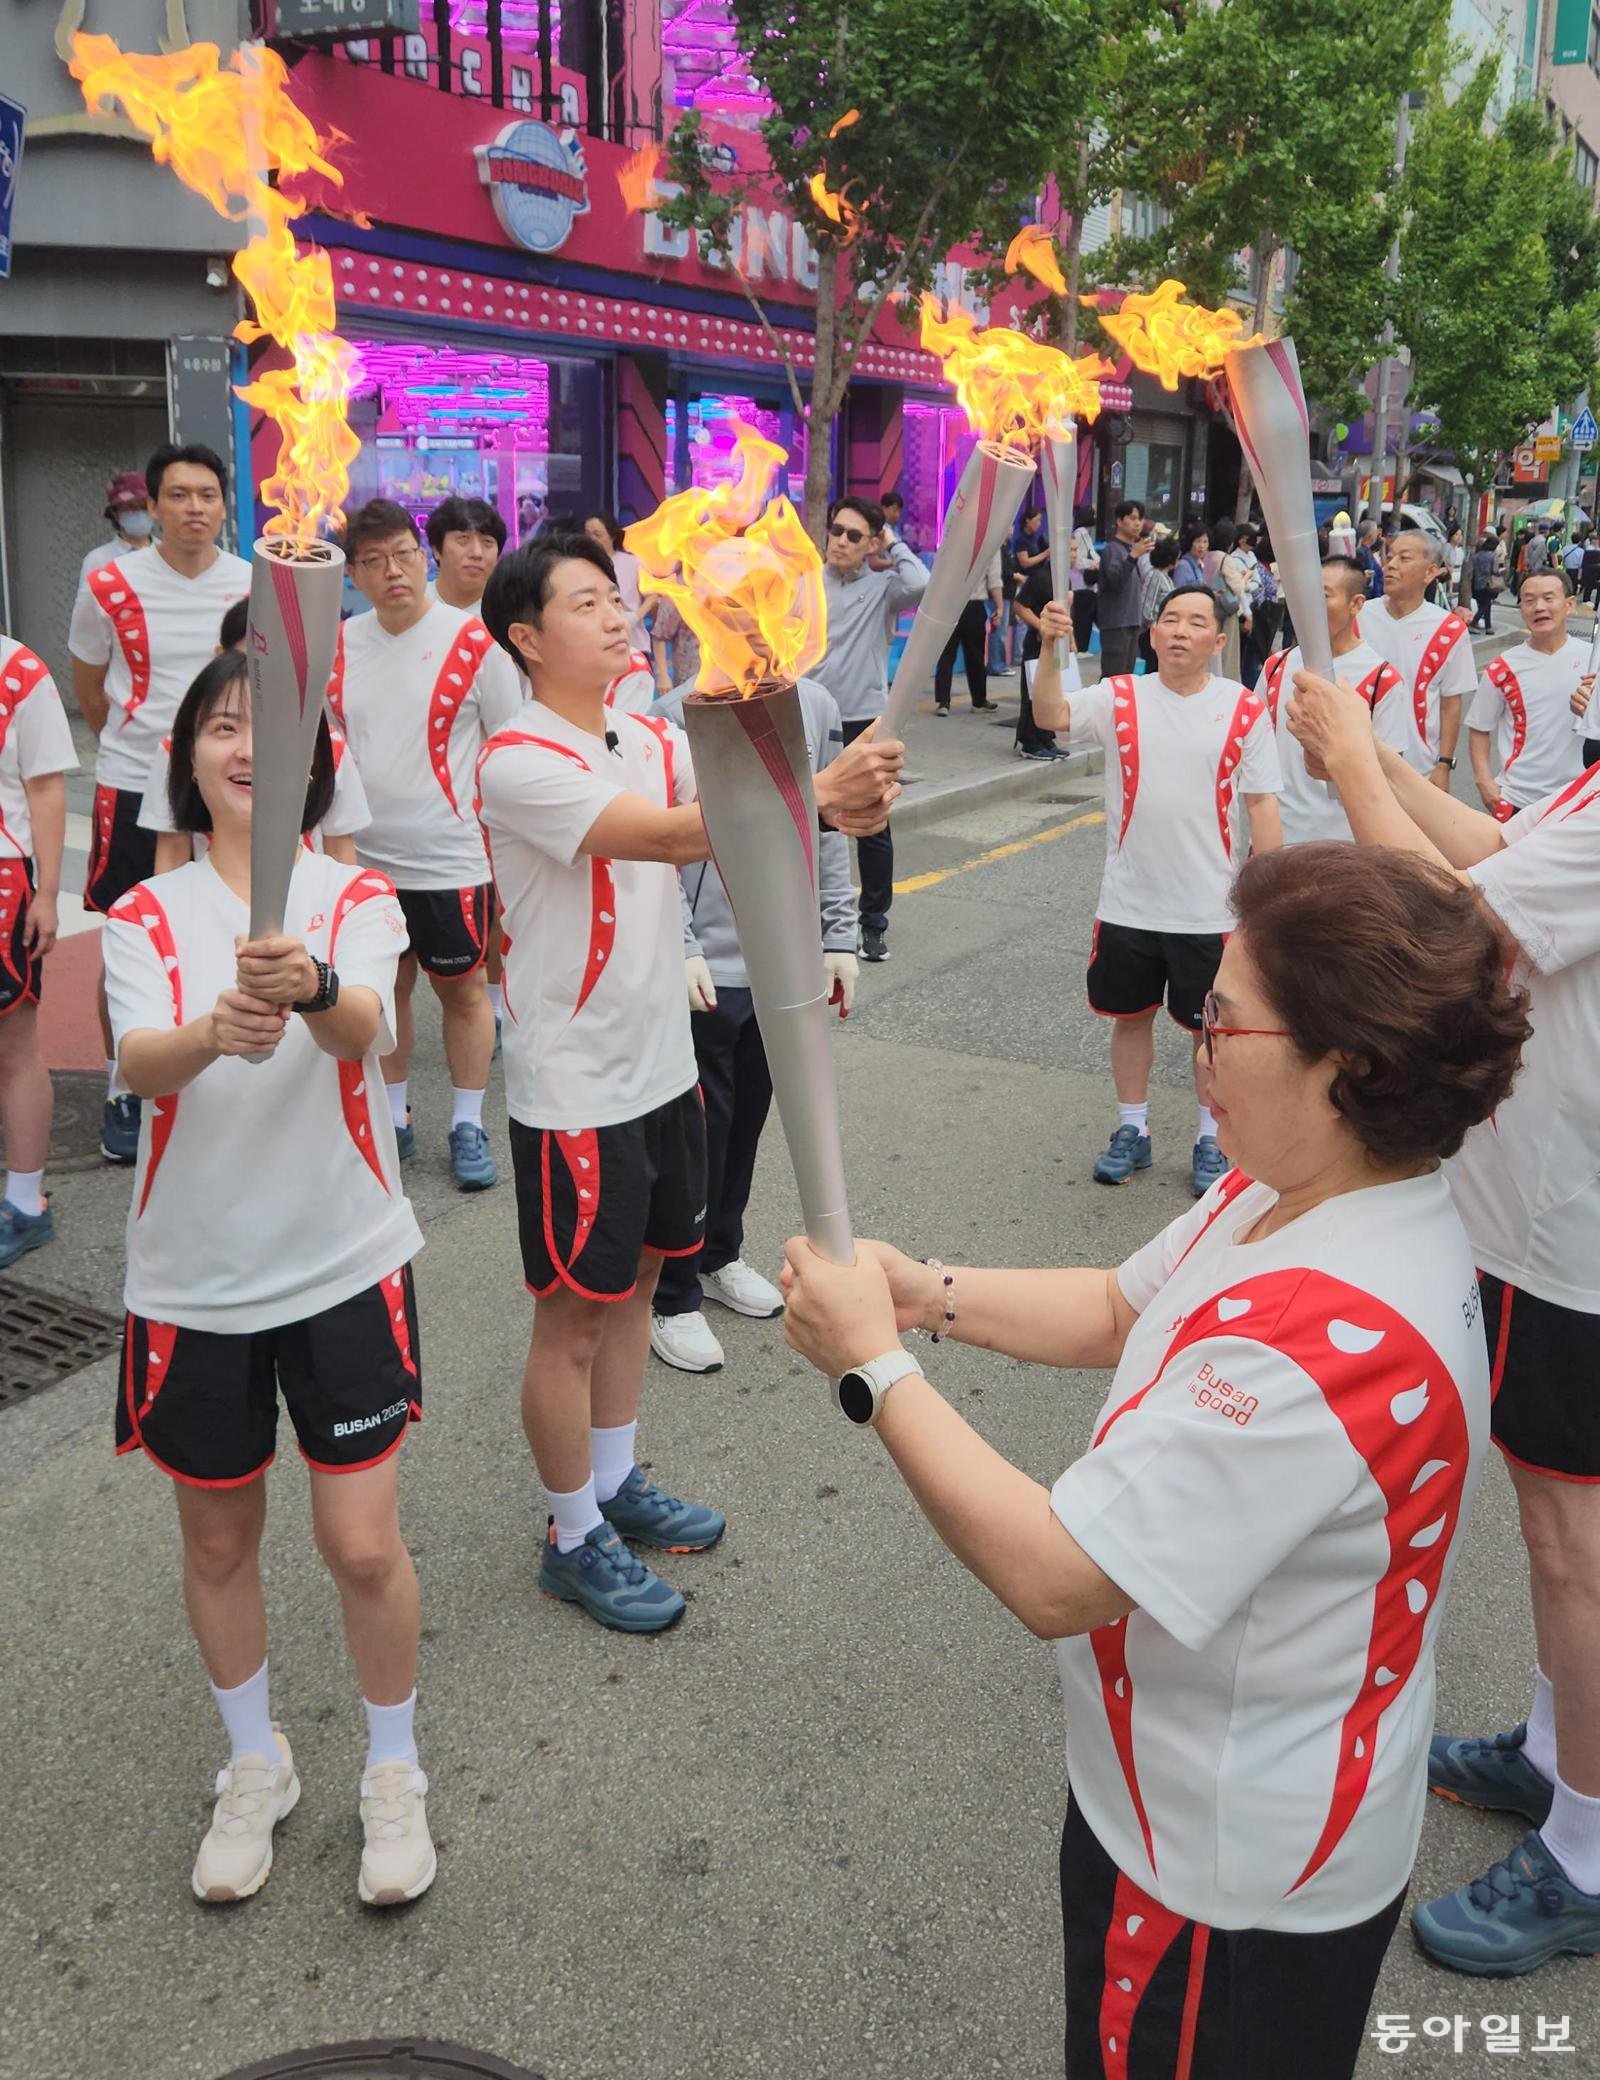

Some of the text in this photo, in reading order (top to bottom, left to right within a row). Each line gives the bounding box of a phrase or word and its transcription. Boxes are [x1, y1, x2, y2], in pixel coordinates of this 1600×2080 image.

[1187, 1381, 1252, 1426] is good
[1197, 1362, 1259, 1412] Busan
[333, 1397, 408, 1437] BUSAN 2025
